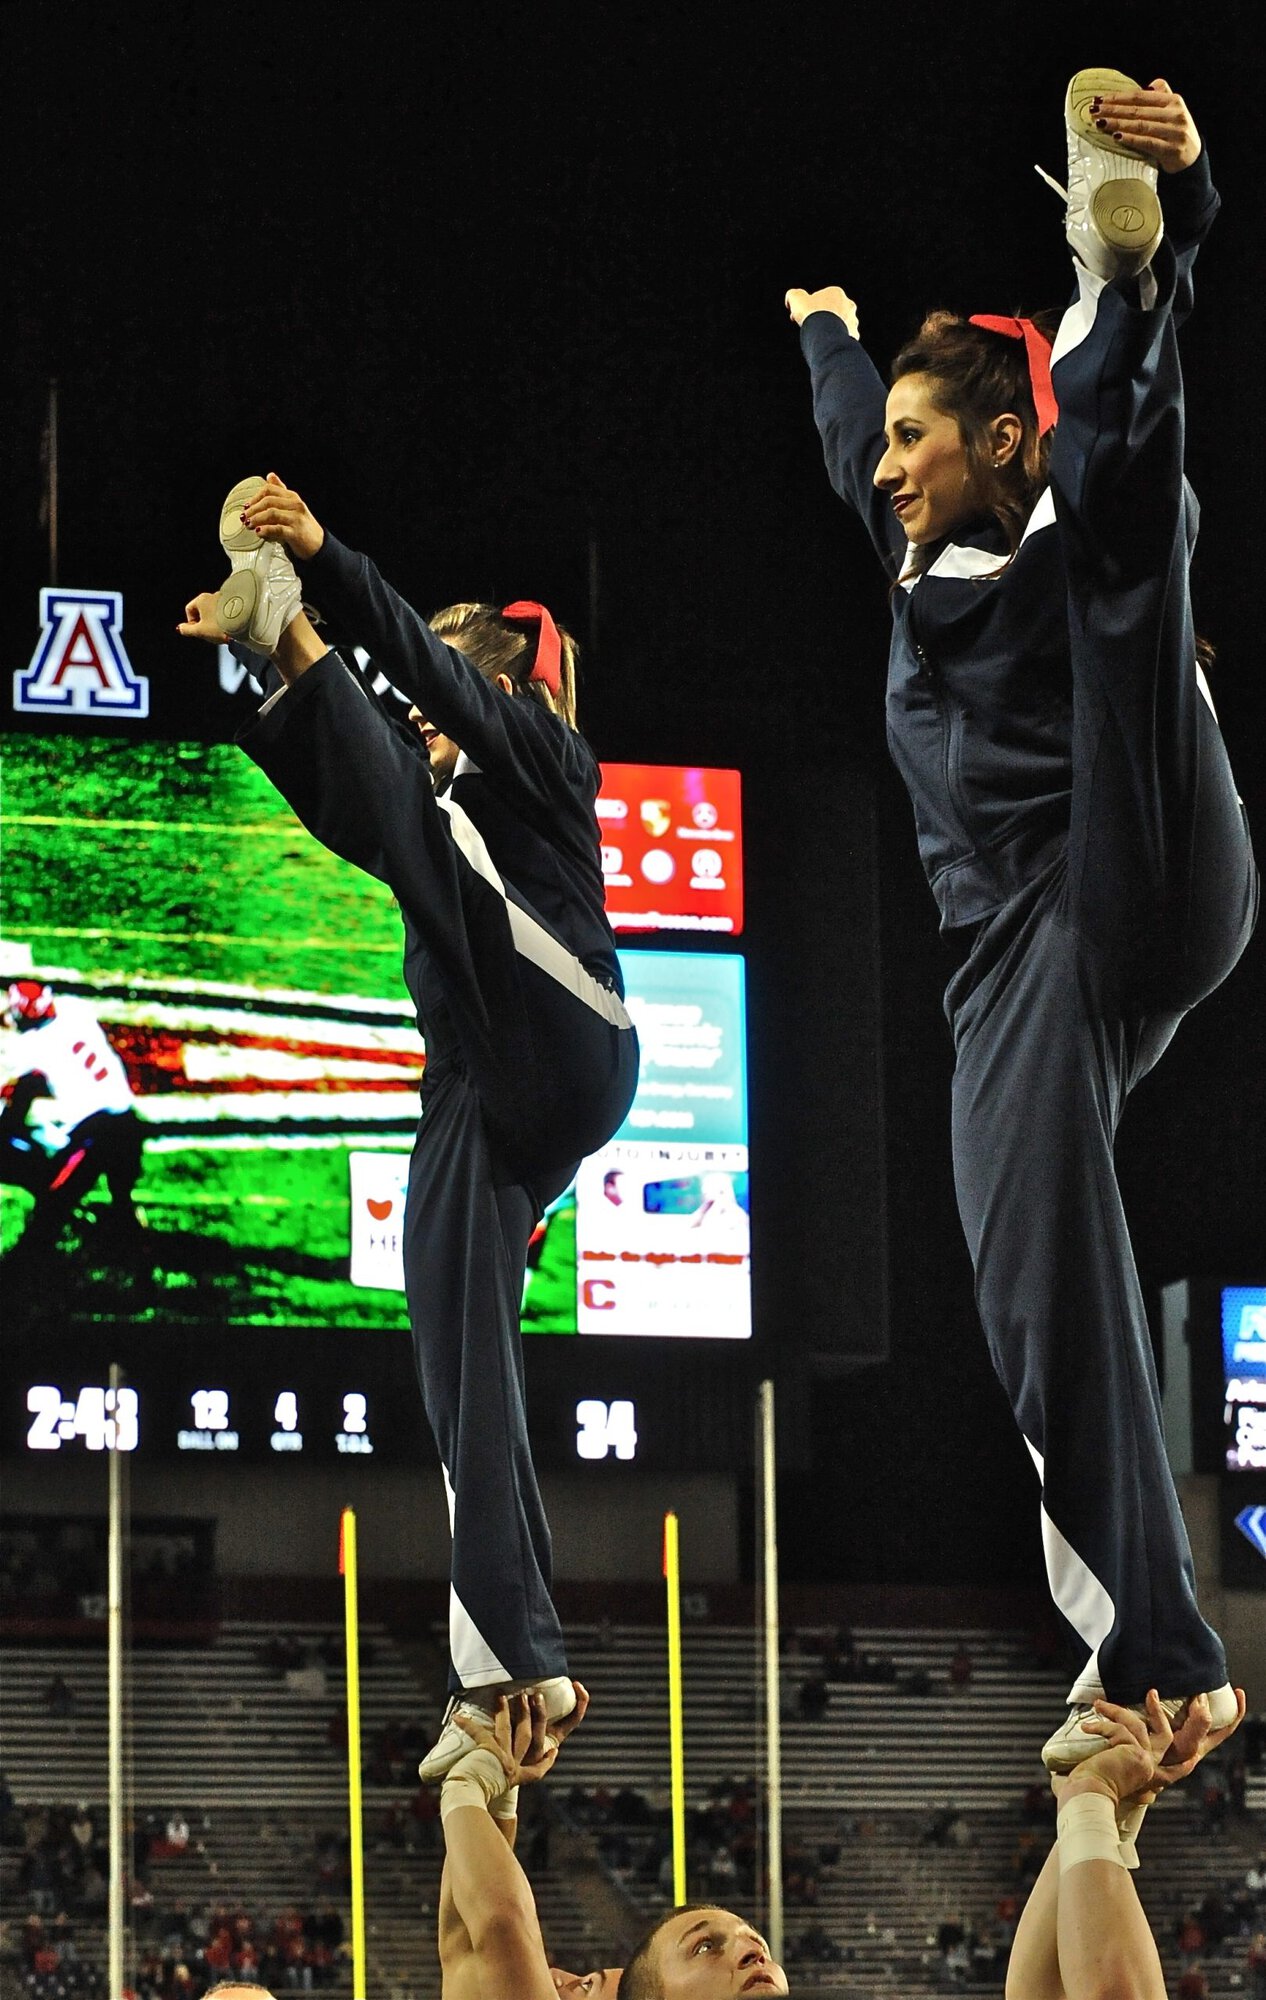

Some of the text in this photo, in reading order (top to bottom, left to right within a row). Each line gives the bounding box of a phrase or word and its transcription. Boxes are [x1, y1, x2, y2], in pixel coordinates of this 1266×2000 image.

[12, 586, 150, 719] A
[26, 1385, 139, 1451] 2:43
[191, 1390, 229, 1430] 12
[274, 1391, 298, 1431] 4
[343, 1393, 367, 1433] 2
[576, 1400, 638, 1460] 34
